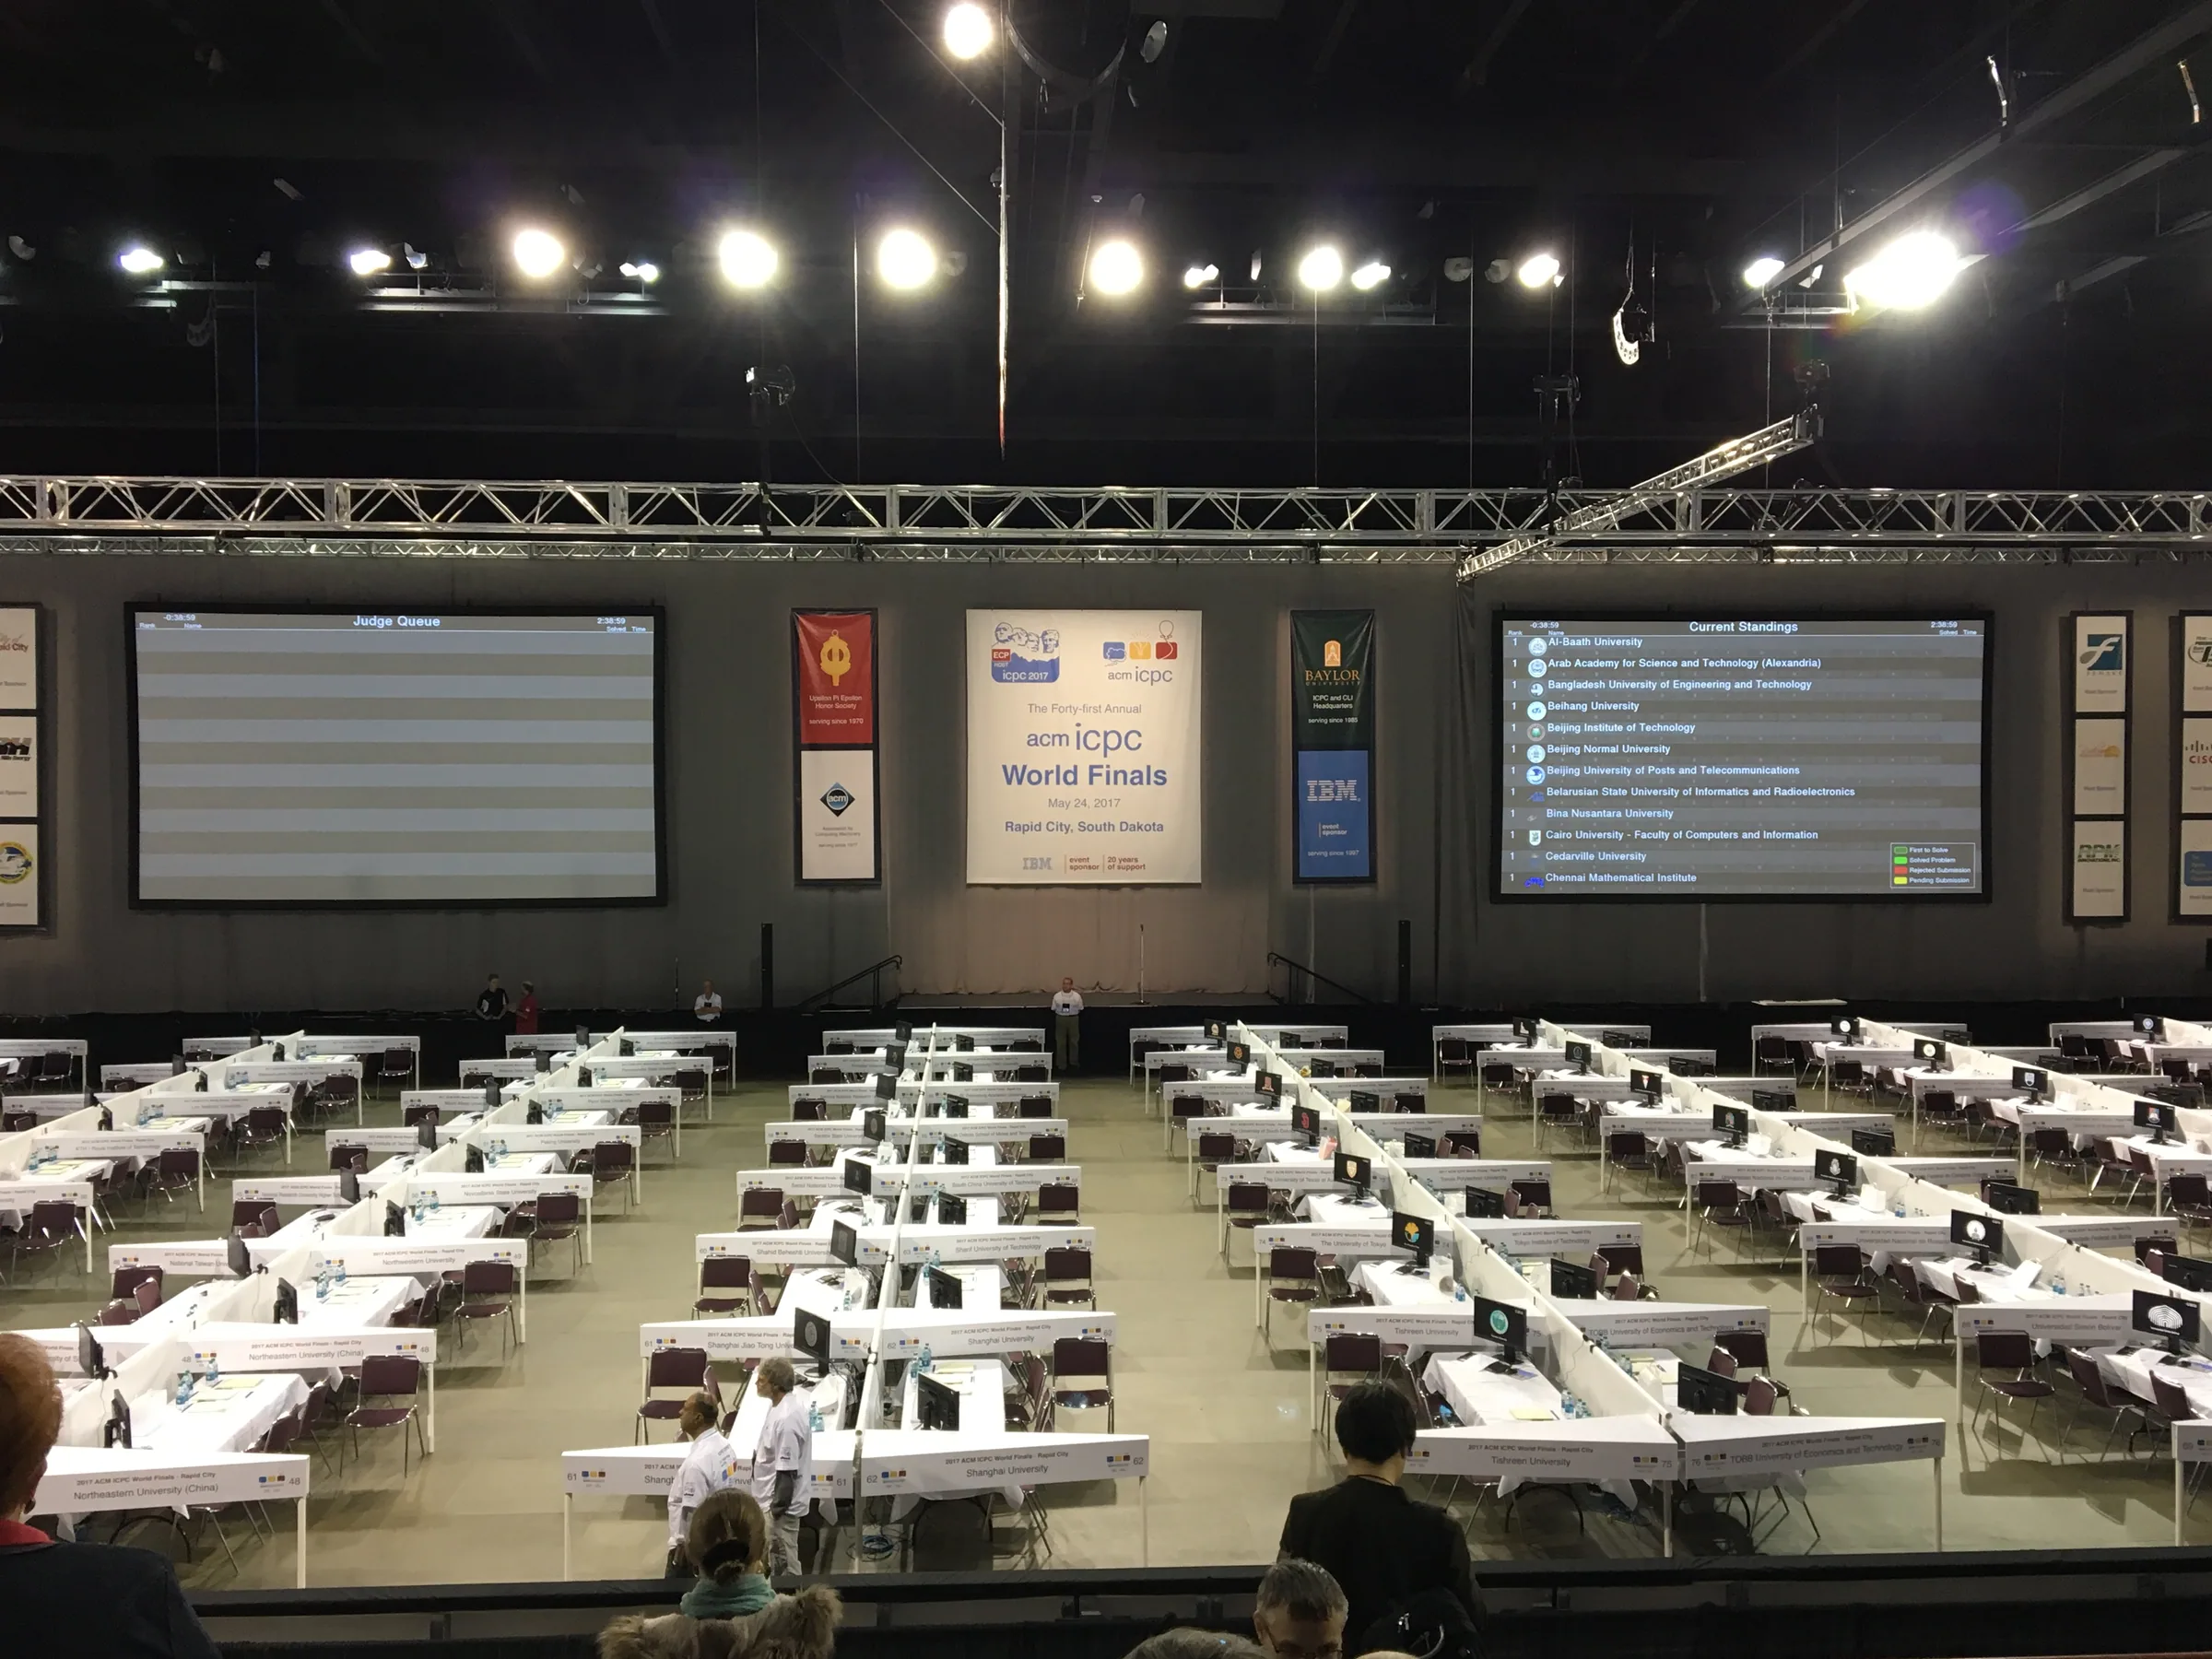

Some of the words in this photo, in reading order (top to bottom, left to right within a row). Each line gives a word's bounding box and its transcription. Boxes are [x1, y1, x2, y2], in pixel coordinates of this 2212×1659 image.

[353, 616, 393, 629] Judge
[397, 616, 441, 627] Queue
[1689, 622, 1735, 632] Current
[1738, 621, 1798, 634] Standings
[1548, 638, 1591, 646] Al-Baath
[1594, 638, 1642, 649] University
[994, 652, 1010, 660] ECP
[1548, 659, 1571, 667] Arab
[1574, 659, 1618, 669] Academy
[1622, 658, 1636, 667] for
[1639, 658, 1677, 667] Science
[1681, 658, 1700, 667] and
[1703, 658, 1759, 669] Technology
[1762, 658, 1821, 669] (Alexandria)
[1003, 670, 1027, 683] icpc
[1029, 672, 1049, 680] 2017
[1108, 670, 1132, 680] acm
[1135, 666, 1172, 686] icpc
[1305, 670, 1360, 681] BAYLOR
[1548, 680, 1606, 691] Bangladesh
[1609, 680, 1657, 691] University
[1660, 680, 1670, 689] of
[1673, 680, 1731, 691] Engineering
[1735, 680, 1752, 689] and
[1756, 680, 1812, 691] Technology
[1028, 704, 1048, 713] The
[1051, 704, 1102, 716] Forty-first
[1104, 704, 1141, 713] Annual
[1547, 702, 1587, 712] Beihang
[1591, 702, 1639, 712] University
[1547, 724, 1581, 734] Beijing
[1584, 724, 1624, 732] Institute
[1628, 724, 1637, 732] of
[1640, 724, 1696, 734] Technology
[1027, 733, 1069, 747] acm
[1076, 723, 1142, 758] icpc
[1547, 745, 1581, 755] Beijing
[1584, 745, 1618, 753] Normal
[1622, 745, 1670, 755] University
[1002, 765, 1078, 785] World
[1088, 765, 1167, 785] Finals
[1547, 766, 1580, 776] Beijing
[1584, 766, 1632, 776] University
[1635, 766, 1645, 775] of
[1648, 766, 1676, 775] Posts
[1678, 766, 1697, 774] and
[1700, 766, 1800, 774] Telecommunications
[1307, 780, 1357, 801] IBM
[1547, 788, 1598, 796] Belarusian
[1602, 788, 1628, 796] State
[1631, 788, 1679, 798] University
[1683, 787, 1692, 796] of
[1695, 787, 1749, 796] Informatics
[1752, 787, 1771, 796] and
[1774, 787, 1855, 796] Radioelectronics
[1048, 798, 1070, 810] May
[1074, 798, 1090, 810] 24,
[1094, 798, 1121, 807] 2017
[1547, 809, 1569, 818] Bina
[1571, 809, 1622, 818] Nusantara
[1625, 809, 1674, 819] University
[1005, 821, 1041, 835] Rapid
[1046, 821, 1073, 835] City,
[1077, 821, 1115, 832] South
[1120, 821, 1163, 832] Dakota
[1575, 831, 1624, 841] University
[1634, 831, 1670, 841] Faculty
[1673, 830, 1683, 839] of
[1686, 830, 1738, 841] Computers
[1742, 830, 1760, 839] and
[1763, 830, 1818, 839] Information
[1546, 853, 1594, 861] Cedarville
[1598, 853, 1646, 863] University
[1023, 858, 1053, 870] IBM
[1117, 864, 1146, 872] support
[1546, 874, 1585, 882] Chennai
[1589, 874, 1653, 882] Mathematical
[1657, 874, 1697, 882] Institute
[1394, 1327, 1424, 1335] Tishreen
[1426, 1327, 1459, 1336] University
[708, 1341, 739, 1349] Shanghai
[758, 1341, 774, 1349] Tong
[968, 1337, 1000, 1346] Shanghai
[1002, 1335, 1034, 1344] University
[249, 1352, 297, 1360] Northeastern
[299, 1351, 335, 1359] University
[337, 1349, 364, 1358] (China)
[1038, 1452, 1055, 1460] Rapid
[1730, 1454, 1753, 1464] TOBB
[1756, 1451, 1793, 1462] University
[1795, 1450, 1803, 1459] of
[1804, 1447, 1843, 1458] Economics
[1847, 1445, 1860, 1454] and
[1863, 1442, 1903, 1453] Technology
[1133, 1457, 1143, 1465] 62
[1491, 1456, 1526, 1465] Tishreen
[1529, 1456, 1571, 1467] University
[1661, 1460, 1672, 1468] 75
[966, 1467, 1006, 1479] Shanghai
[1008, 1465, 1049, 1476] University
[288, 1477, 300, 1486] 48
[866, 1475, 877, 1483] 62
[74, 1489, 134, 1500] Northeastern
[136, 1486, 182, 1498] University
[184, 1483, 218, 1495] (China)
